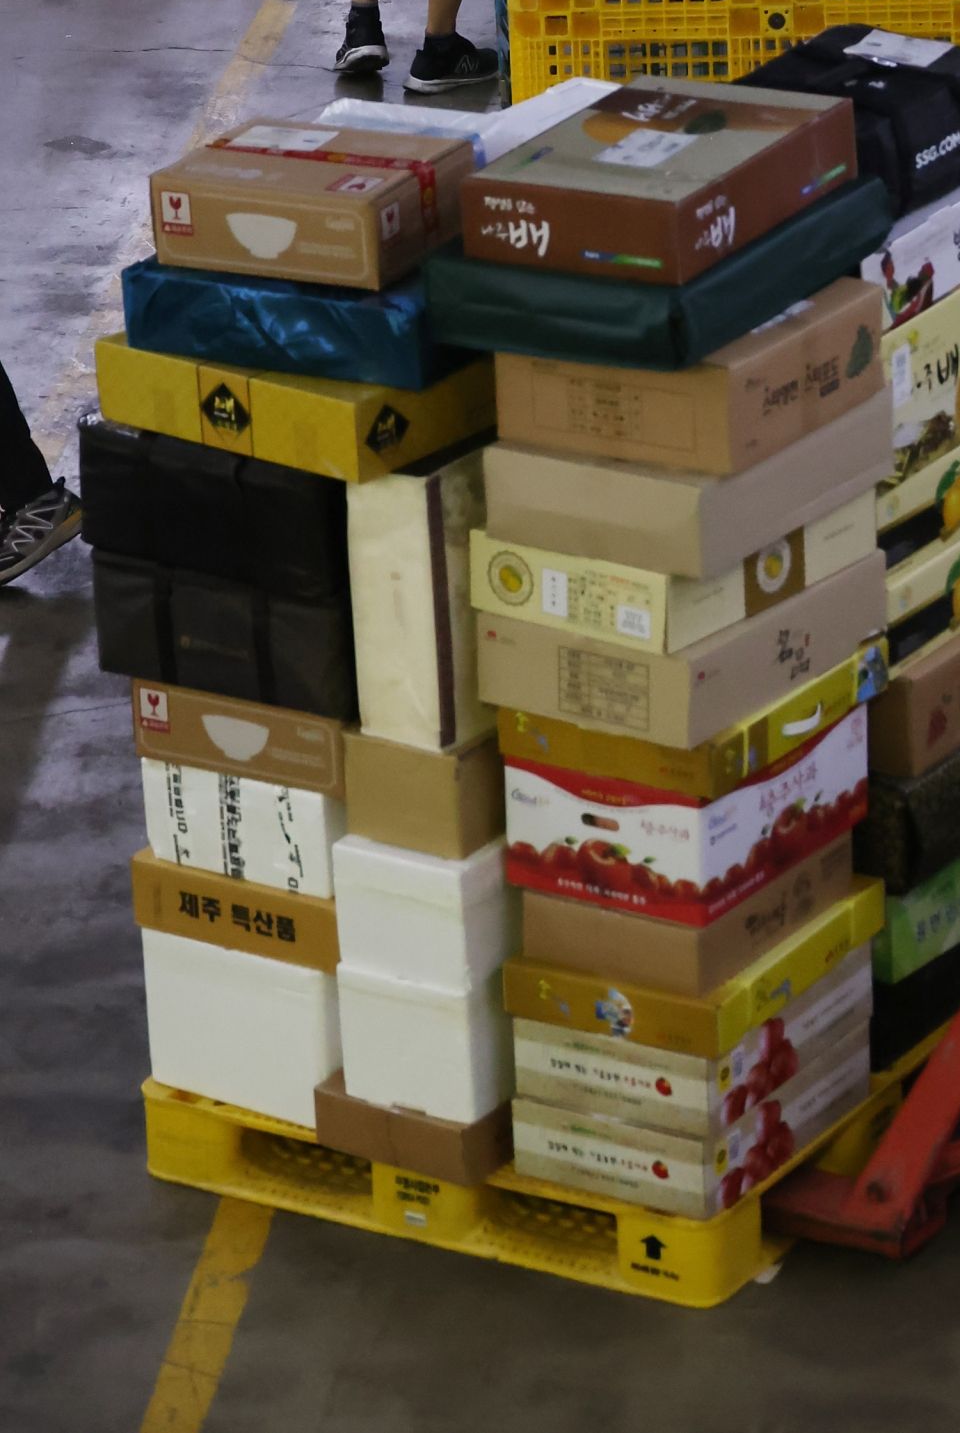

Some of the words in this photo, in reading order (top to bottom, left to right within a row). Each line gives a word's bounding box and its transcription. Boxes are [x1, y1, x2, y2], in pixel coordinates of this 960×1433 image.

[480, 218, 550, 258] 나주배
[178, 889, 222, 923] 제주
[229, 903, 298, 943] 특산품
